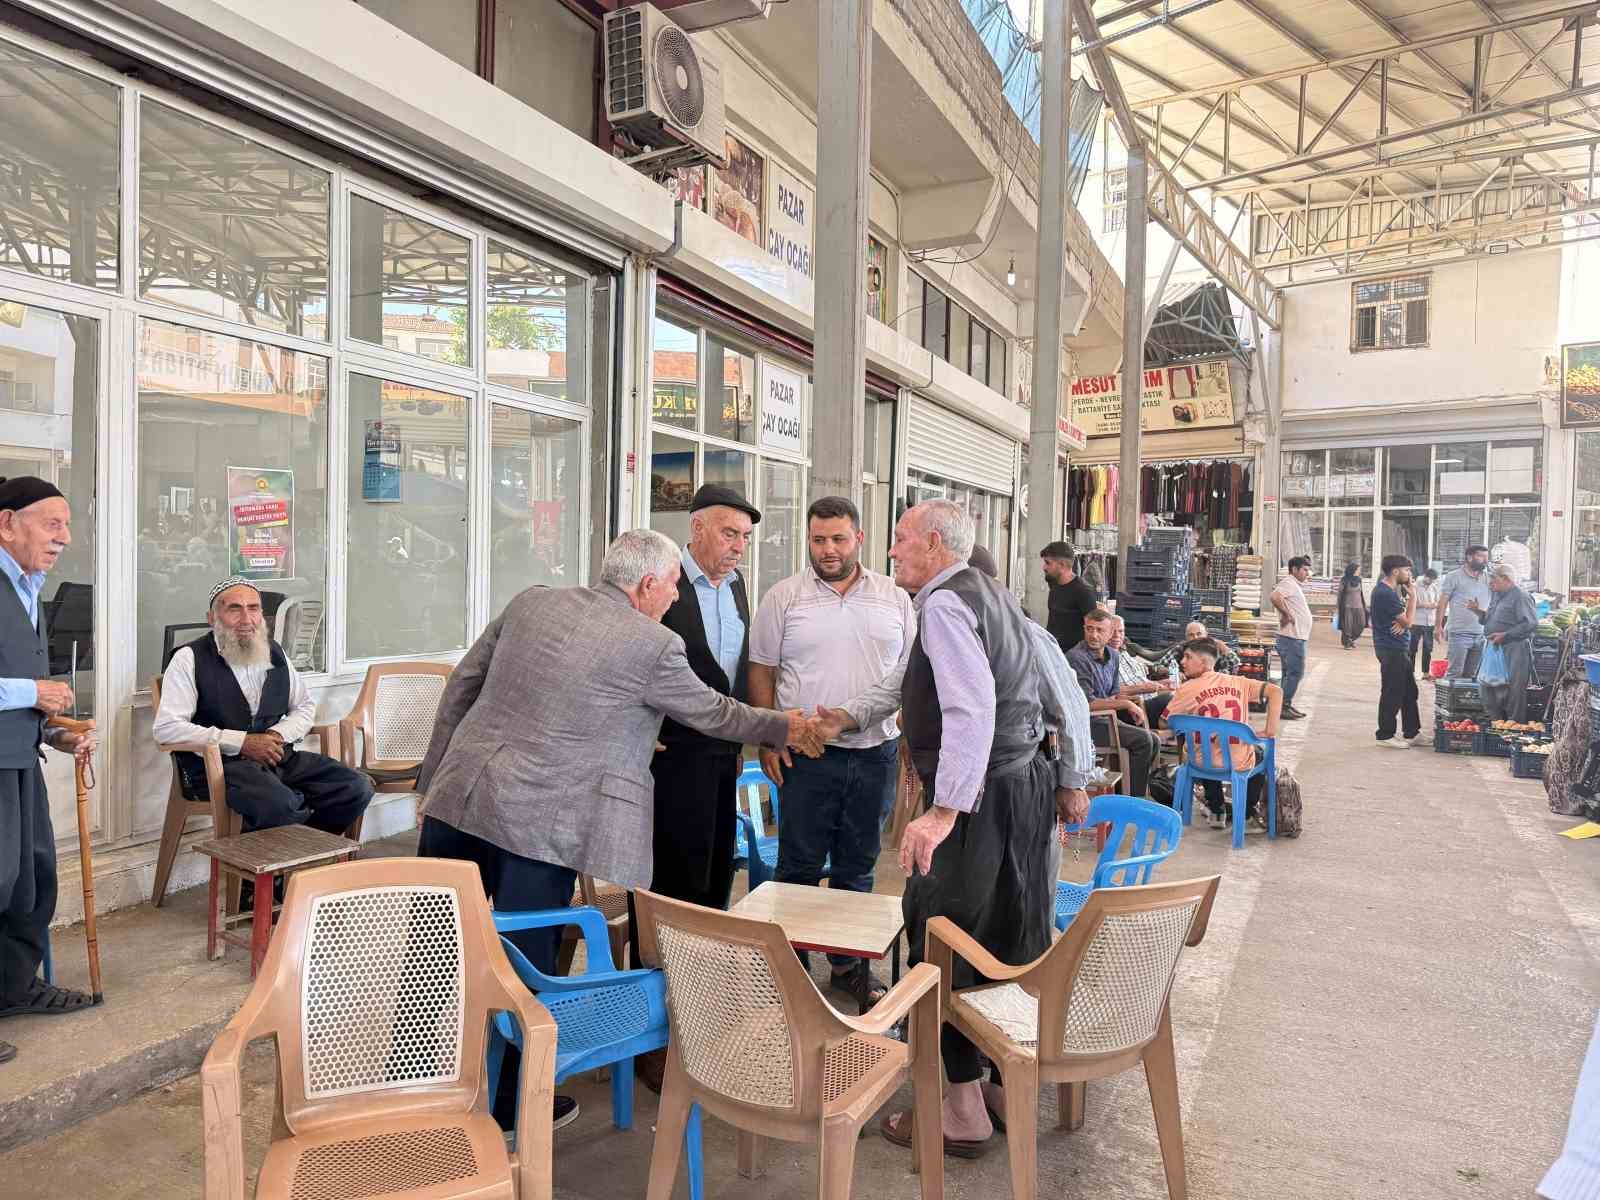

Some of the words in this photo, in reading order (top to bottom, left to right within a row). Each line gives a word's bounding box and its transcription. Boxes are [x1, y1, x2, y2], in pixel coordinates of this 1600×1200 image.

[778, 184, 804, 225] PAZAR
[787, 240, 811, 278] OCAĞI
[770, 380, 794, 405] PAZAR
[1072, 375, 1116, 395] MESUT
[1099, 395, 1121, 404] NEVRE
[777, 416, 800, 439] OCAĞI
